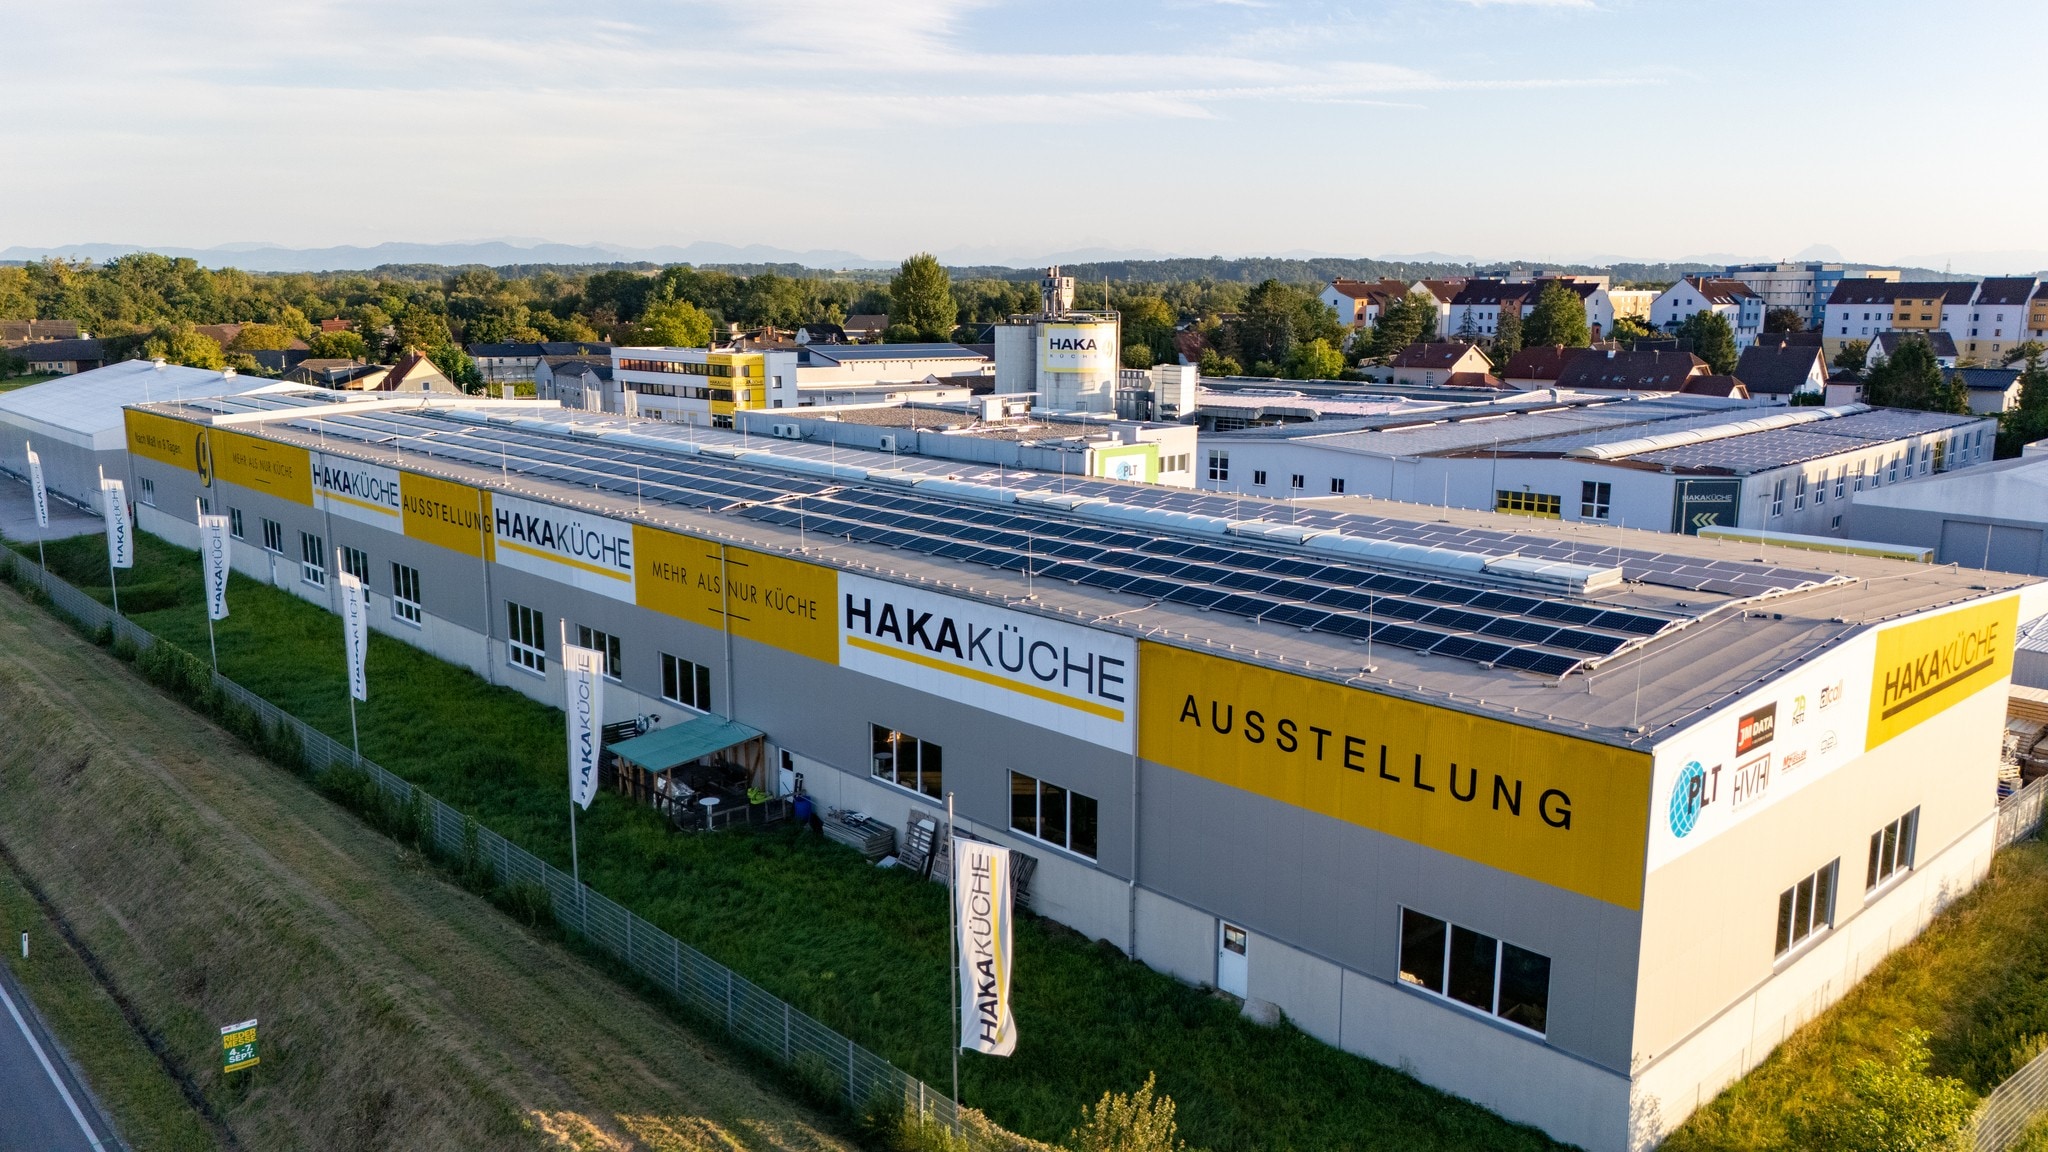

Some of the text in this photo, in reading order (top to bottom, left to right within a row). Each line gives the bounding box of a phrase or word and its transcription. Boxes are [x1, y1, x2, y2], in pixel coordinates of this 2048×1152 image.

[1050, 338, 1097, 350] HAKA
[232, 451, 294, 480] MEHR ALS NUR KÜCHE
[312, 463, 400, 508] HAKAKÜCHE
[1123, 465, 1138, 477] PLT
[403, 495, 492, 534] AUSSTELLUNG
[496, 508, 631, 570] HAKAKÜCHE
[652, 560, 817, 620] MEHR ALS NUR KÜCHE
[845, 593, 1126, 703] HAKAKÜCHE
[1883, 621, 1999, 707] HAKAKÜCHE
[1179, 694, 1573, 832] AUSSTELLUNG
[1732, 759, 1768, 806] HVH
[1687, 764, 1722, 815] PLT
[969, 853, 998, 1045] HAKAKÜCHE
[223, 1028, 257, 1042] RIEDER
[224, 1035, 257, 1049] MESSE
[229, 1051, 255, 1063] SEPT.
